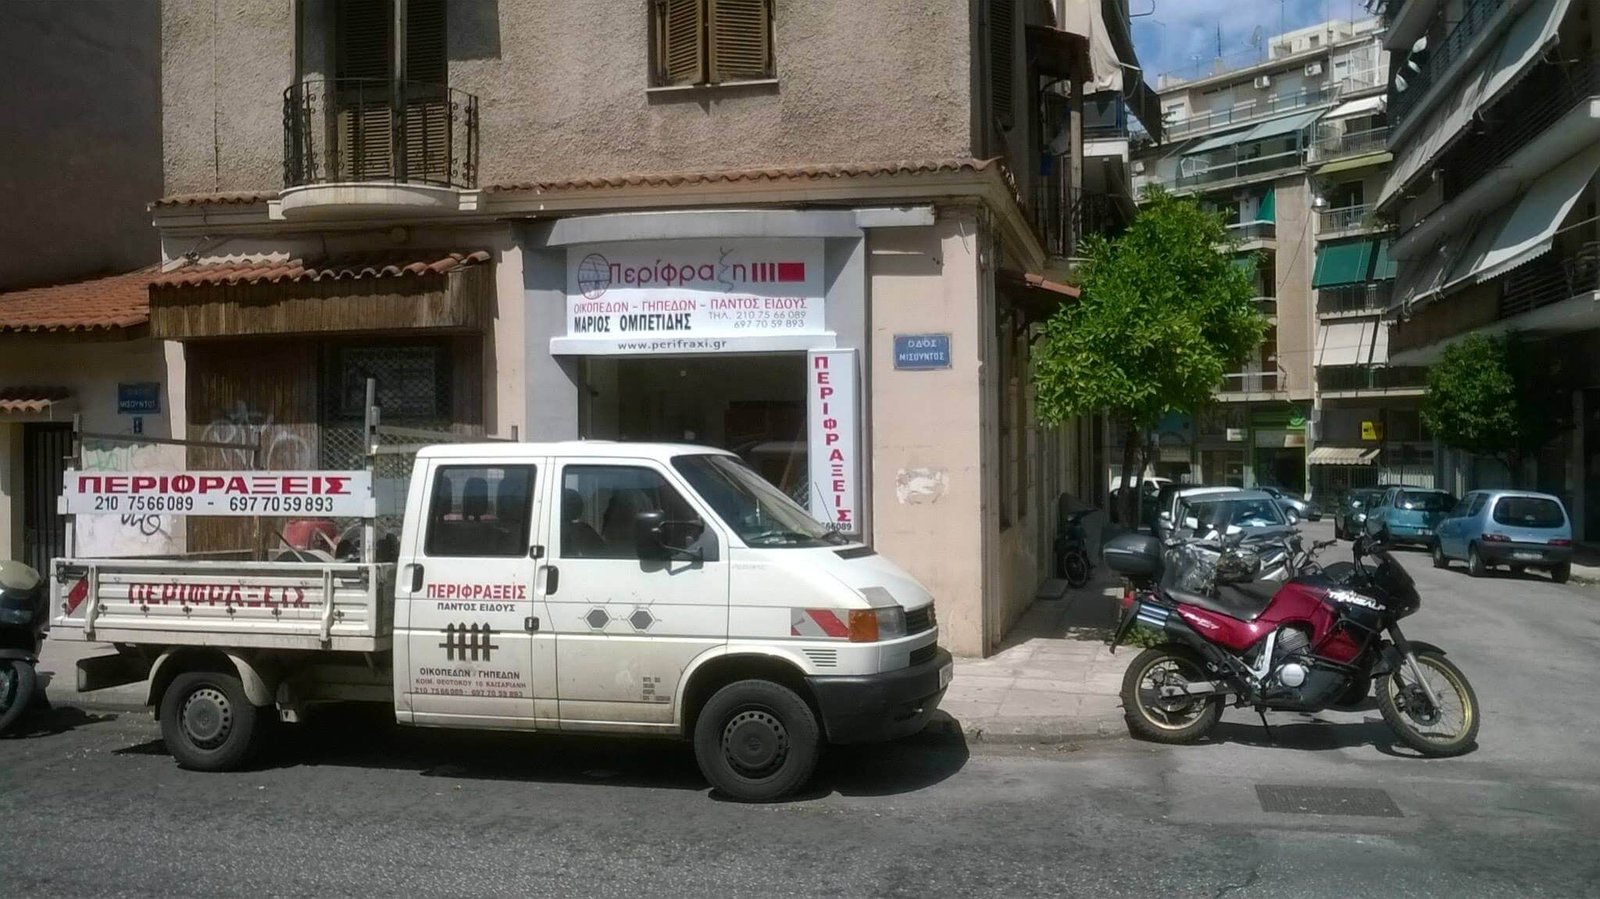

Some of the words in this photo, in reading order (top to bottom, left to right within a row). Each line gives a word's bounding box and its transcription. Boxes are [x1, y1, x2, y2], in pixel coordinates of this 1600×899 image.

[609, 246, 746, 294] Περίφραξη
[574, 301, 629, 314] ΟΙΚΟΠΕΔΩΝ
[642, 300, 697, 312] ΓΗΠΕΔΩΝ
[710, 298, 760, 310] ΠΑΝΤΟΣ
[764, 297, 807, 309] ΕΙΔΟΥΣ
[736, 311, 755, 319] 210
[757, 311, 770, 319] 75
[773, 311, 785, 319] 66
[788, 311, 807, 319] 089
[574, 315, 611, 333] ΜΑΡΙΟΣ
[619, 313, 692, 332] ΟΜΠΕΤΙΔΗΣ
[733, 320, 752, 328] 697
[755, 320, 768, 328] 70
[770, 320, 782, 328] 59
[785, 319, 804, 328] 893
[618, 338, 727, 351] www.perifraxi.gr
[907, 339, 937, 348] ΟΔΟΣ
[899, 352, 945, 361] ΜΙΣΟΥΝΤΟΣ
[814, 356, 852, 522] ΠΕΡΙΦΡΑΞΕΙΣ
[78, 475, 352, 496] ΠΕΡΙΦΡΑΞΕΙΣ
[95, 496, 119, 512] 210
[427, 584, 526, 599] ΠΕΡΙΦΡΑΞΕΙΣ
[437, 603, 477, 611] ΠΑΝΤΟΣ
[480, 603, 516, 612] ΕΙΔΟΥΣ
[420, 667, 471, 677] ΟΙΚΟΠΕΔΩΝ
[478, 670, 520, 680] ΓΗΠΕΔΩΝ
